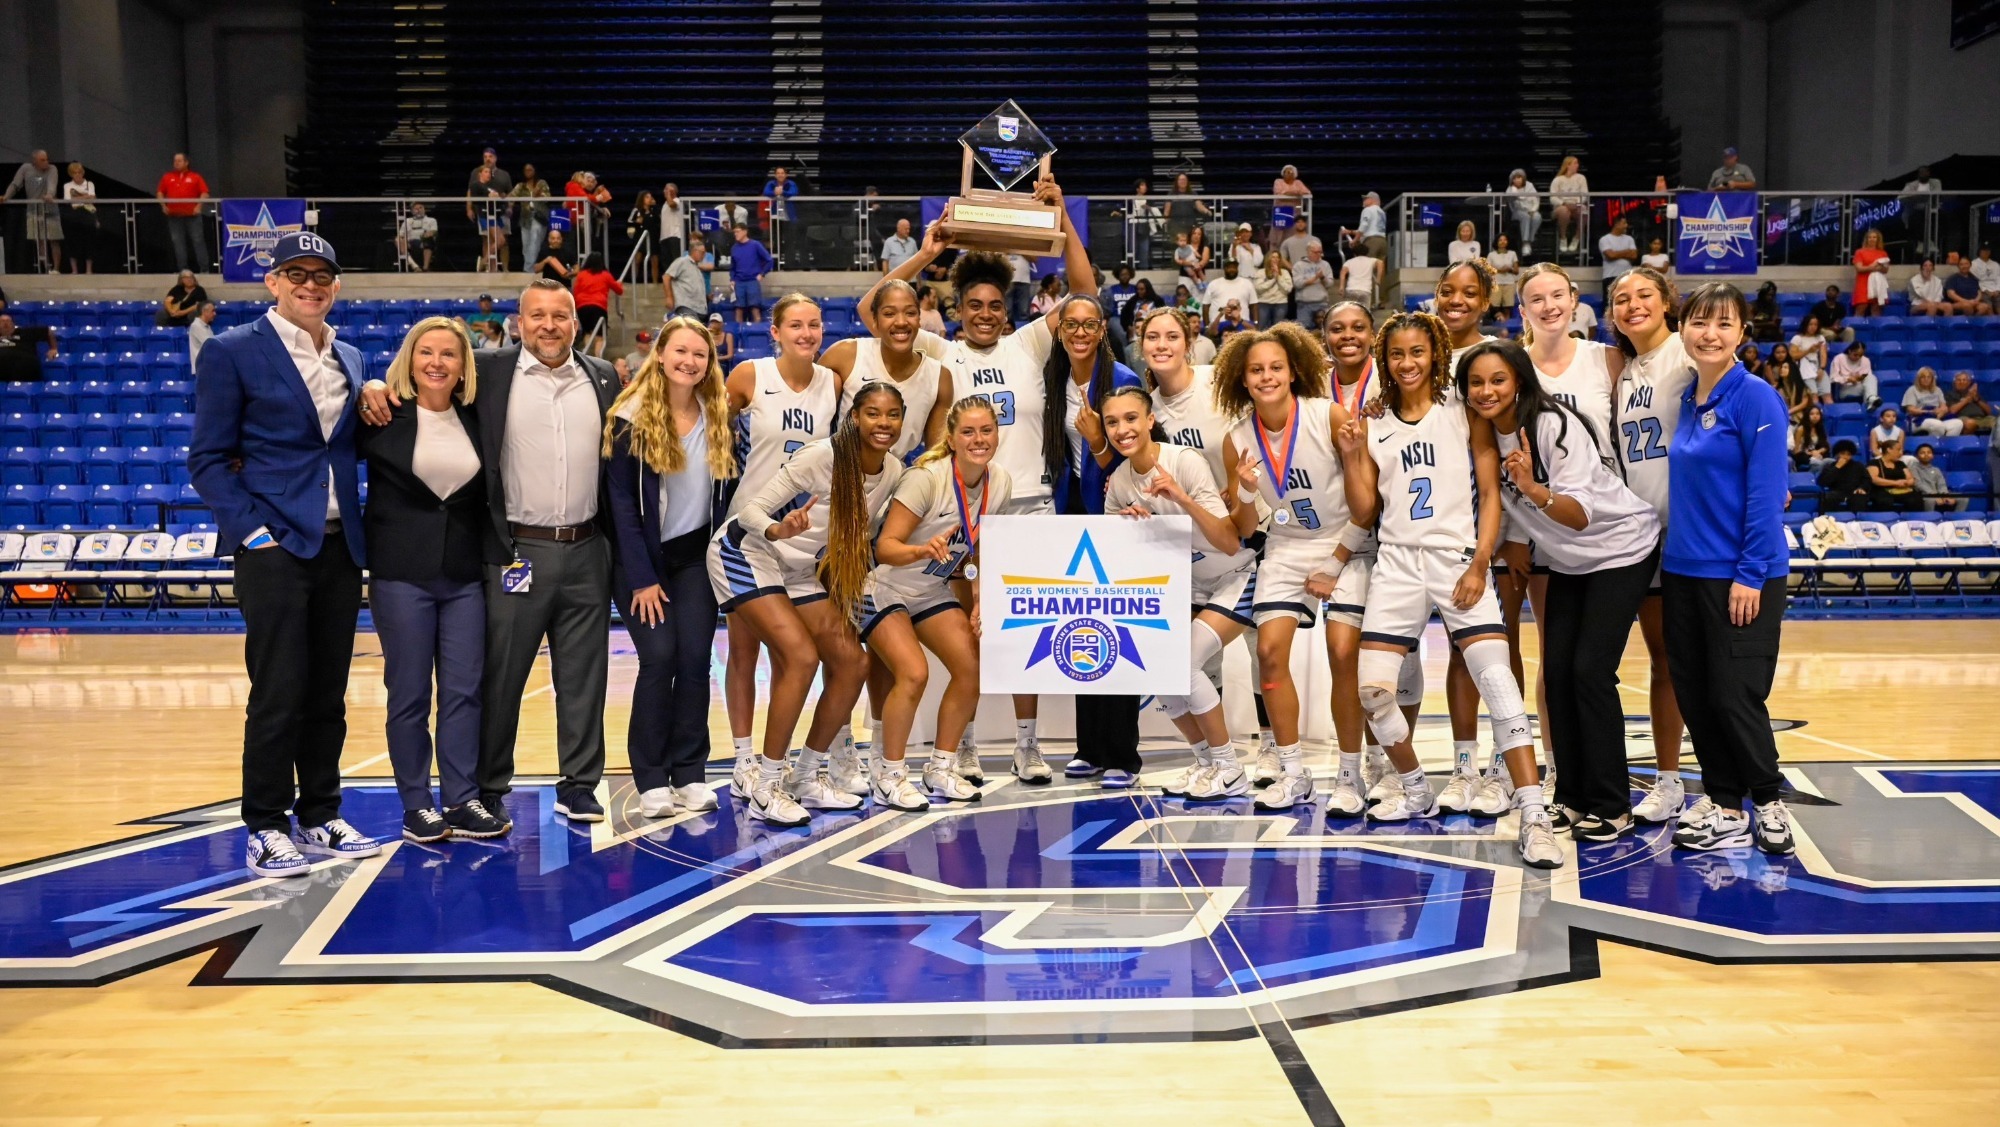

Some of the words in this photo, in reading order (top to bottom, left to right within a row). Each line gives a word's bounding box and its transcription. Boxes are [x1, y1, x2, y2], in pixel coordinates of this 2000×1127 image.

[1686, 223, 1748, 231] CHAMPIONSHIP
[299, 235, 324, 254] GO
[973, 368, 1005, 388] NSU
[974, 391, 1015, 426] 3
[1552, 393, 1577, 410] SU
[1625, 385, 1654, 413] NSU
[782, 408, 814, 435] NSU
[1621, 416, 1668, 463] 22
[1400, 441, 1435, 473] NSU
[1408, 477, 1434, 520] 2
[1291, 497, 1321, 530] 5
[1006, 587, 1032, 595] 2026
[1038, 587, 1089, 595] WOMEN'S
[1095, 587, 1165, 595] BASKETBALL
[1011, 597, 1160, 615] CHAMPIONS
[1055, 628, 1069, 665] SUNSHINE
[1069, 620, 1092, 629] STATE
[1094, 622, 1116, 665] CONFERENCE
[1072, 635, 1099, 644] 50
[1068, 670, 1103, 680] 1975-2025
